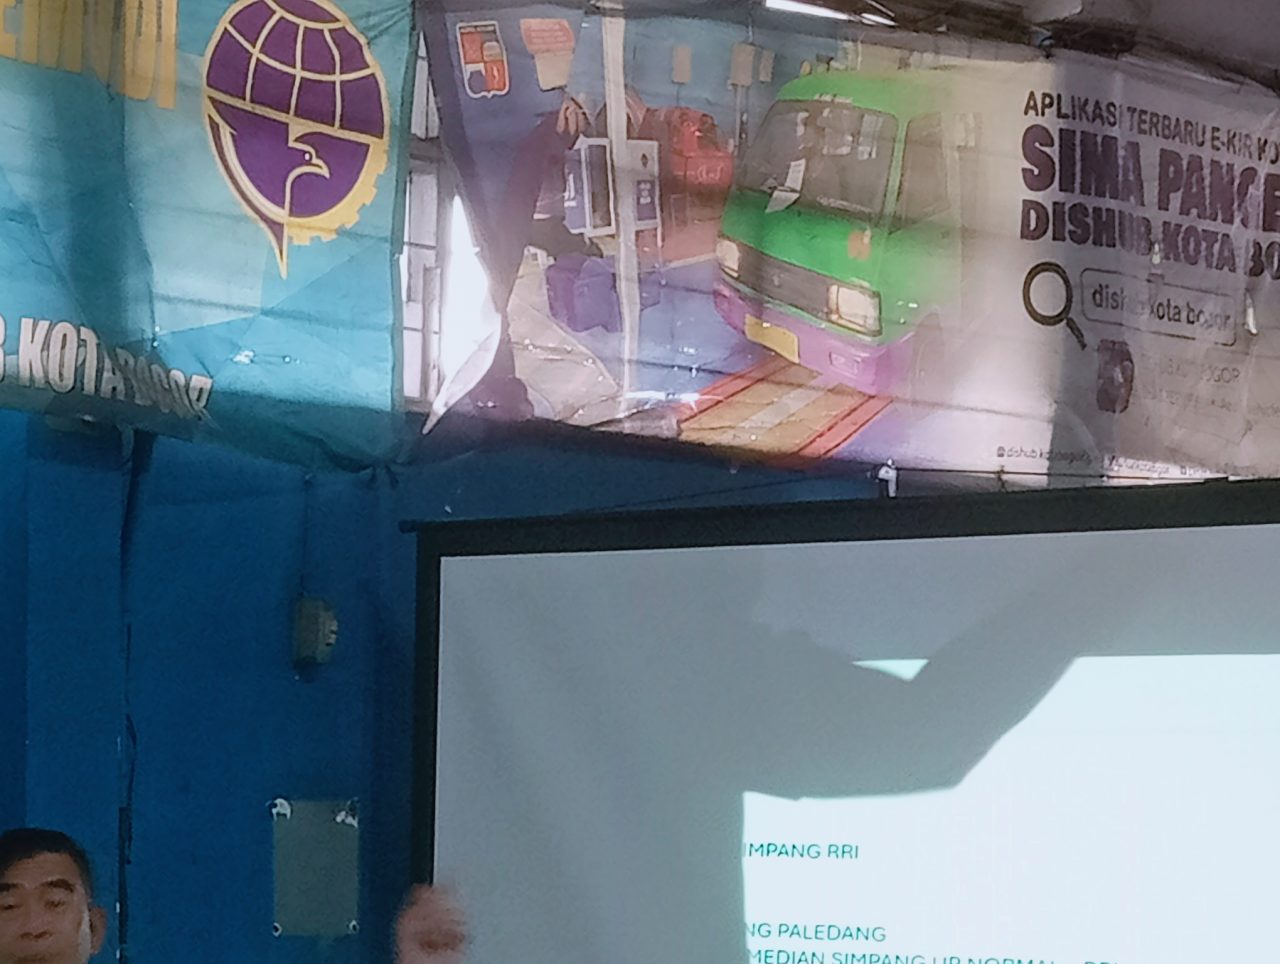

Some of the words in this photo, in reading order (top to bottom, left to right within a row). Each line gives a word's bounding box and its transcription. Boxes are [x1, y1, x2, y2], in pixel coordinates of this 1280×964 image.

[1127, 106, 1205, 148] TERBARU
[1211, 126, 1251, 160] E-KIR
[1021, 124, 1145, 207] SIMA
[1162, 221, 1236, 273] KOTA
[826, 844, 860, 860] RRI
[777, 923, 887, 943] PALEDANG
